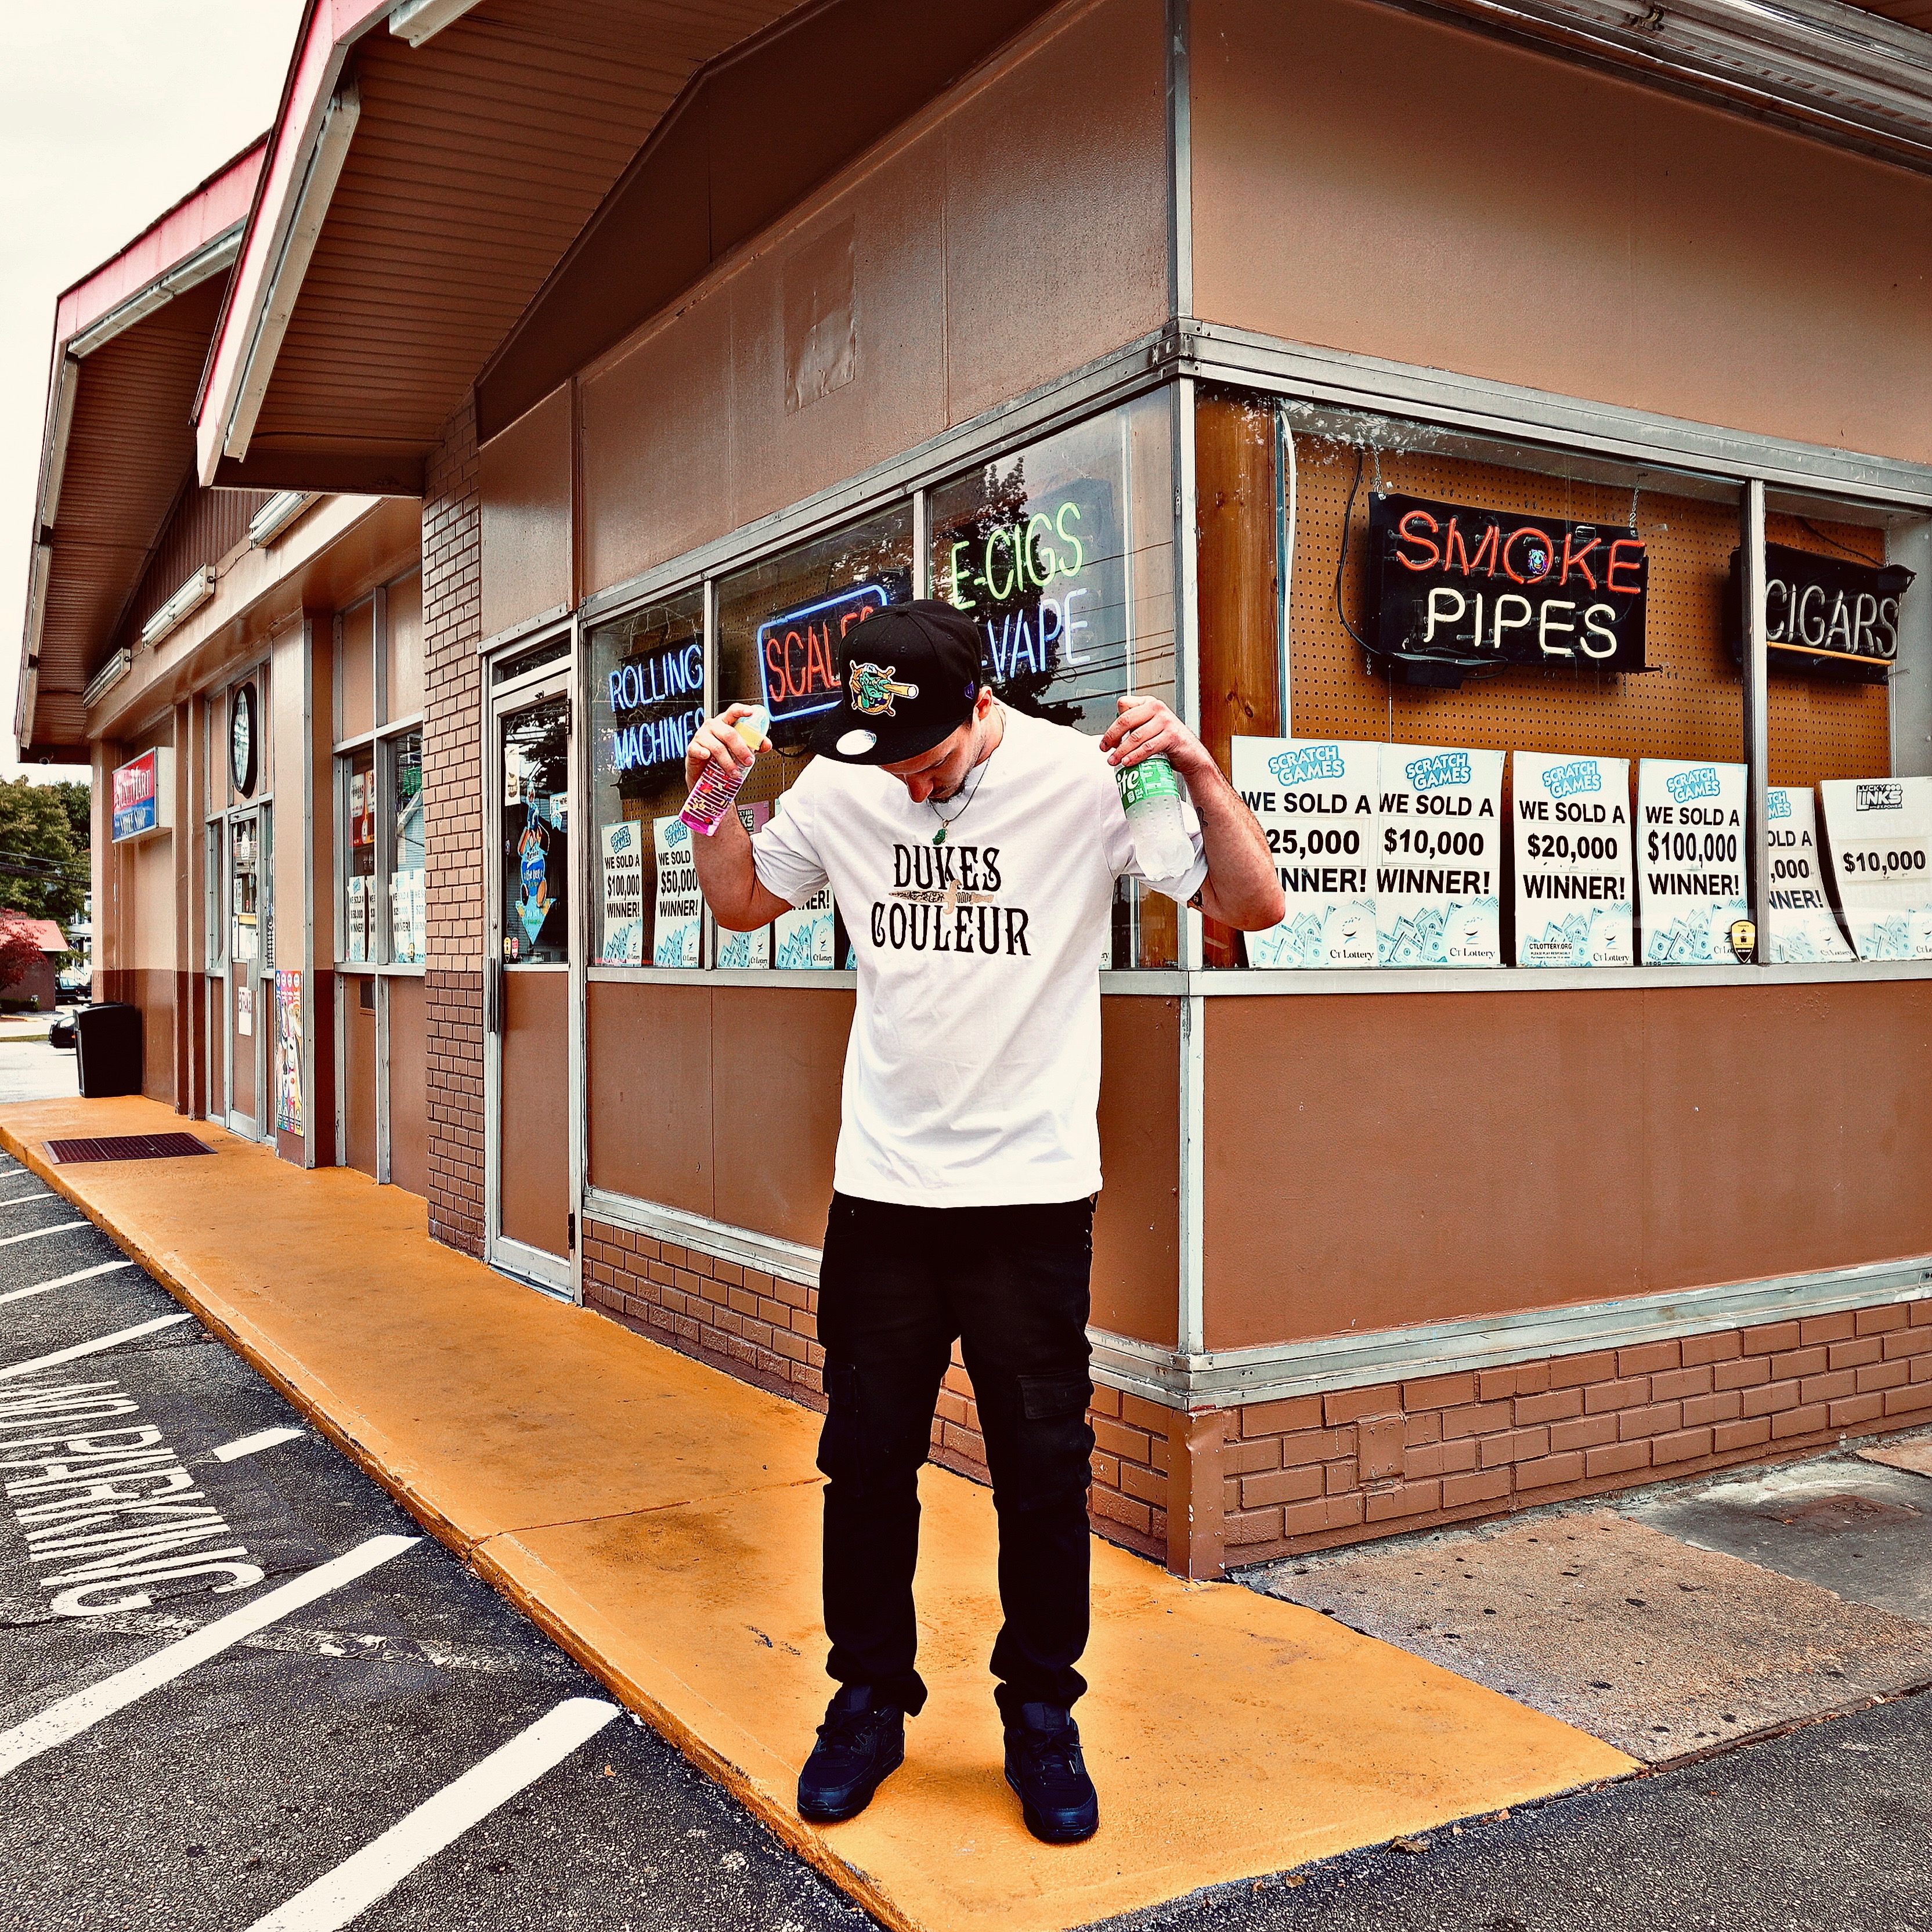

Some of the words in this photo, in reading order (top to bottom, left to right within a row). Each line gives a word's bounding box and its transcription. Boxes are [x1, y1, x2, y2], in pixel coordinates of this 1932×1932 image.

[951, 501, 1084, 610] E-CIGS
[1396, 511, 1646, 594] SMOKE
[1423, 587, 1617, 659] PIPES
[1766, 579, 1898, 658] CIGARS
[767, 606, 874, 702] SCAL
[609, 644, 703, 712] ROLLING
[1268, 745, 1338, 774] SCRATCH
[1406, 753, 1468, 779] SCRATCH
[1278, 759, 1344, 786] GAMES
[1413, 767, 1471, 791] GAMES
[1543, 761, 1596, 786] SCRATCH
[1667, 768, 1716, 792] SCRATCH
[1550, 774, 1601, 799] GAMES
[1674, 780, 1720, 803] GAMES
[1241, 791, 1276, 811] WE
[1284, 793, 1347, 813] SOLD
[1355, 795, 1371, 814] A
[1379, 794, 1409, 813] WE
[1416, 795, 1472, 816] SOLD
[1478, 798, 1494, 817] A
[1519, 800, 1549, 820] WE
[1555, 802, 1604, 822] SOLD
[1612, 805, 1625, 823] A
[1768, 802, 1792, 820] MES
[1857, 790, 1902, 810] LINKS
[1646, 807, 1673, 824] WE
[1679, 807, 1725, 826] SOLD
[1729, 809, 1740, 826] A
[1266, 829, 1360, 860] 25,000
[1384, 828, 1483, 860] $10,000
[1527, 833, 1617, 862] $20,000
[1648, 830, 1736, 868] $100,000
[1768, 830, 1796, 847] OLD
[1801, 830, 1812, 846] A
[605, 855, 615, 869] WE
[616, 854, 633, 868] SOLD
[635, 854, 640, 867] A
[659, 853, 669, 866] WE
[671, 850, 691, 865] SOLD
[893, 844, 1001, 891] DUKES
[1843, 851, 1926, 874] $10,000
[661, 868, 698, 897] $50,000
[1275, 868, 1367, 893] NNER!
[1377, 869, 1490, 894] WINNER!
[1771, 859, 1810, 883] ,000
[607, 874, 640, 900] $100,000
[1523, 875, 1625, 900] WINNER!
[1648, 873, 1739, 895] WINNER!
[606, 902, 640, 918] WINNER!
[660, 900, 698, 918] WINNER!
[1769, 890, 1823, 909] NNER!
[872, 901, 1031, 955] COULEUR
[1344, 949, 1375, 961] Lottery
[1464, 948, 1496, 959] Lottery
[1604, 953, 1630, 962] Lottery
[0, 1424, 265, 1617] PARKING
